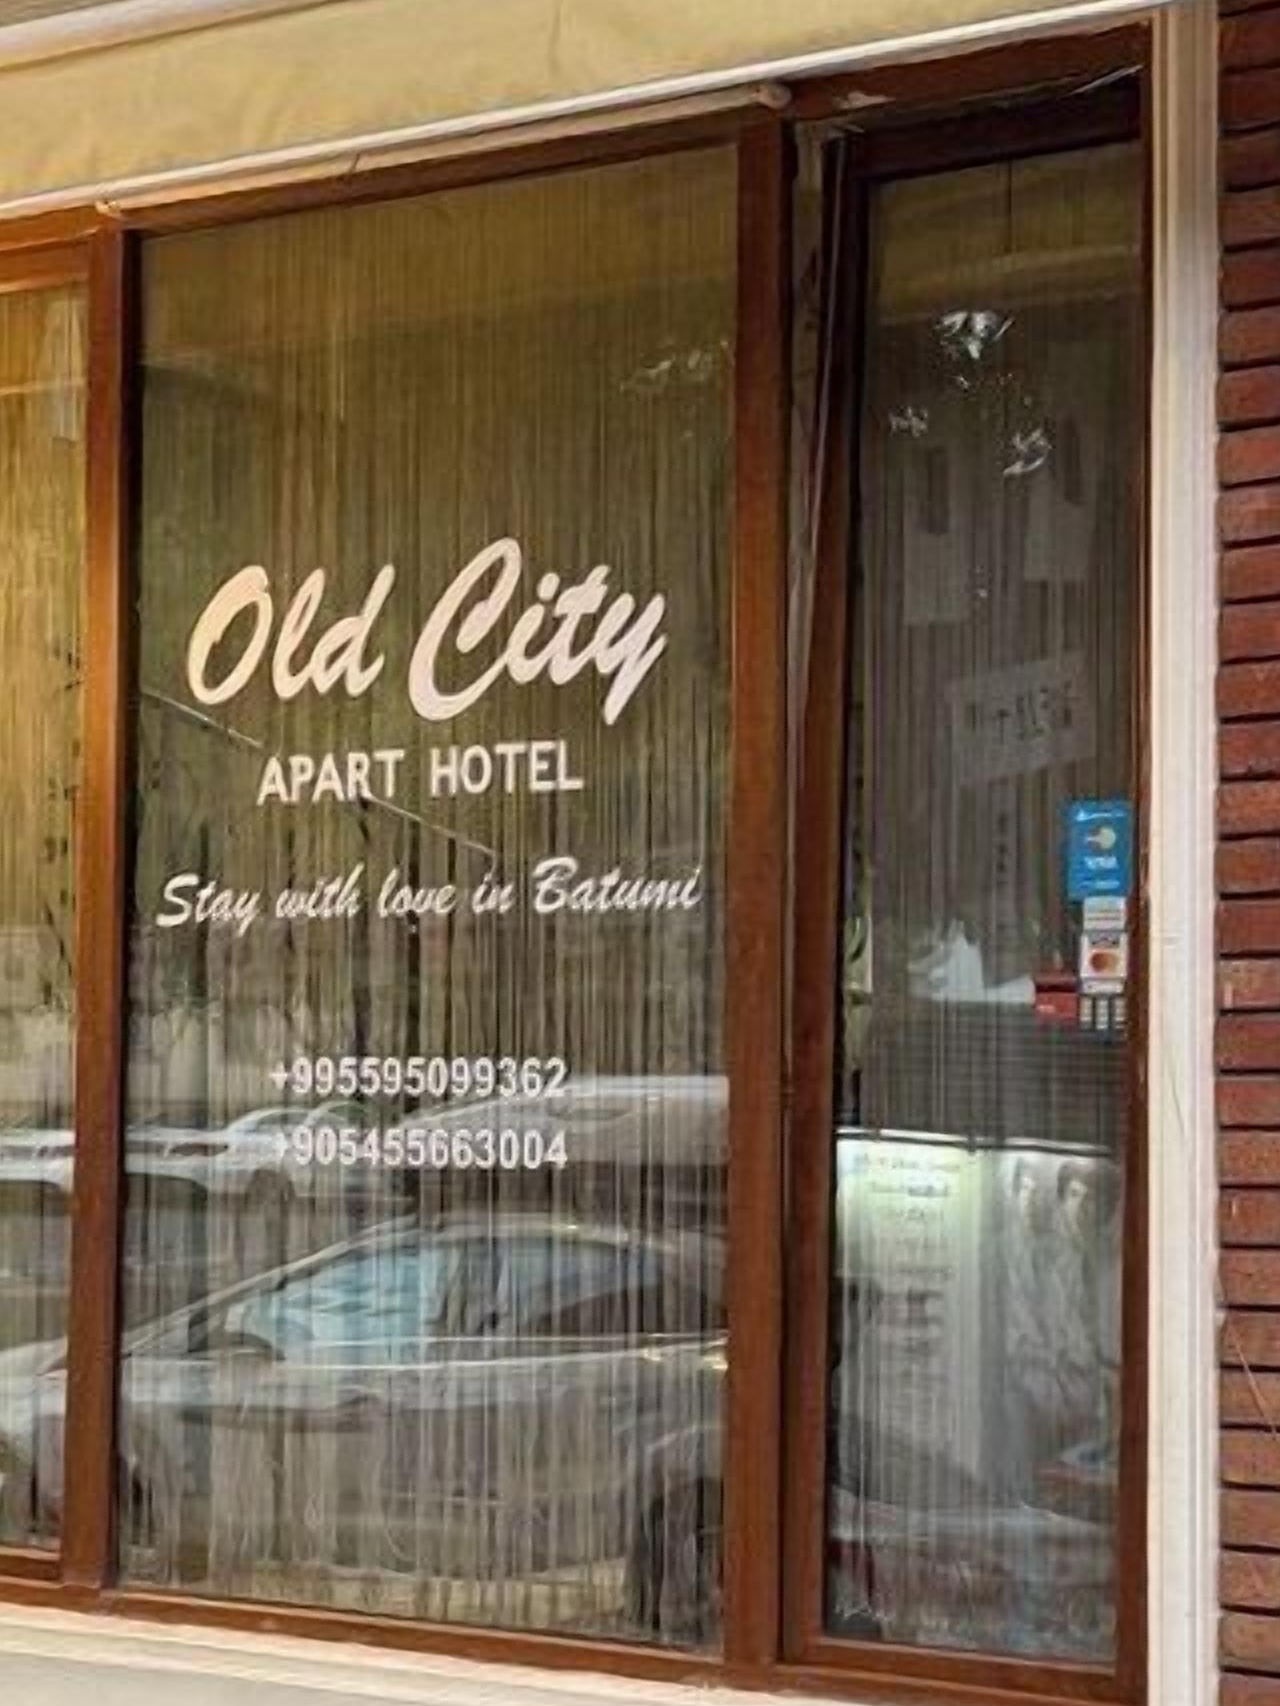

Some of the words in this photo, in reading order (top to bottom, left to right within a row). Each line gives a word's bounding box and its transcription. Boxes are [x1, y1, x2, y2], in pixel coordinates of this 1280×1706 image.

[187, 563, 395, 706] Old
[407, 536, 668, 726] City
[256, 748, 405, 806] APART
[429, 739, 585, 797] HOTEL
[156, 872, 261, 938] Stay
[274, 862, 366, 921] with
[377, 867, 457, 920] love
[471, 871, 516, 916] in
[532, 855, 705, 915] Batumi
[269, 1056, 570, 1099] +995595099362
